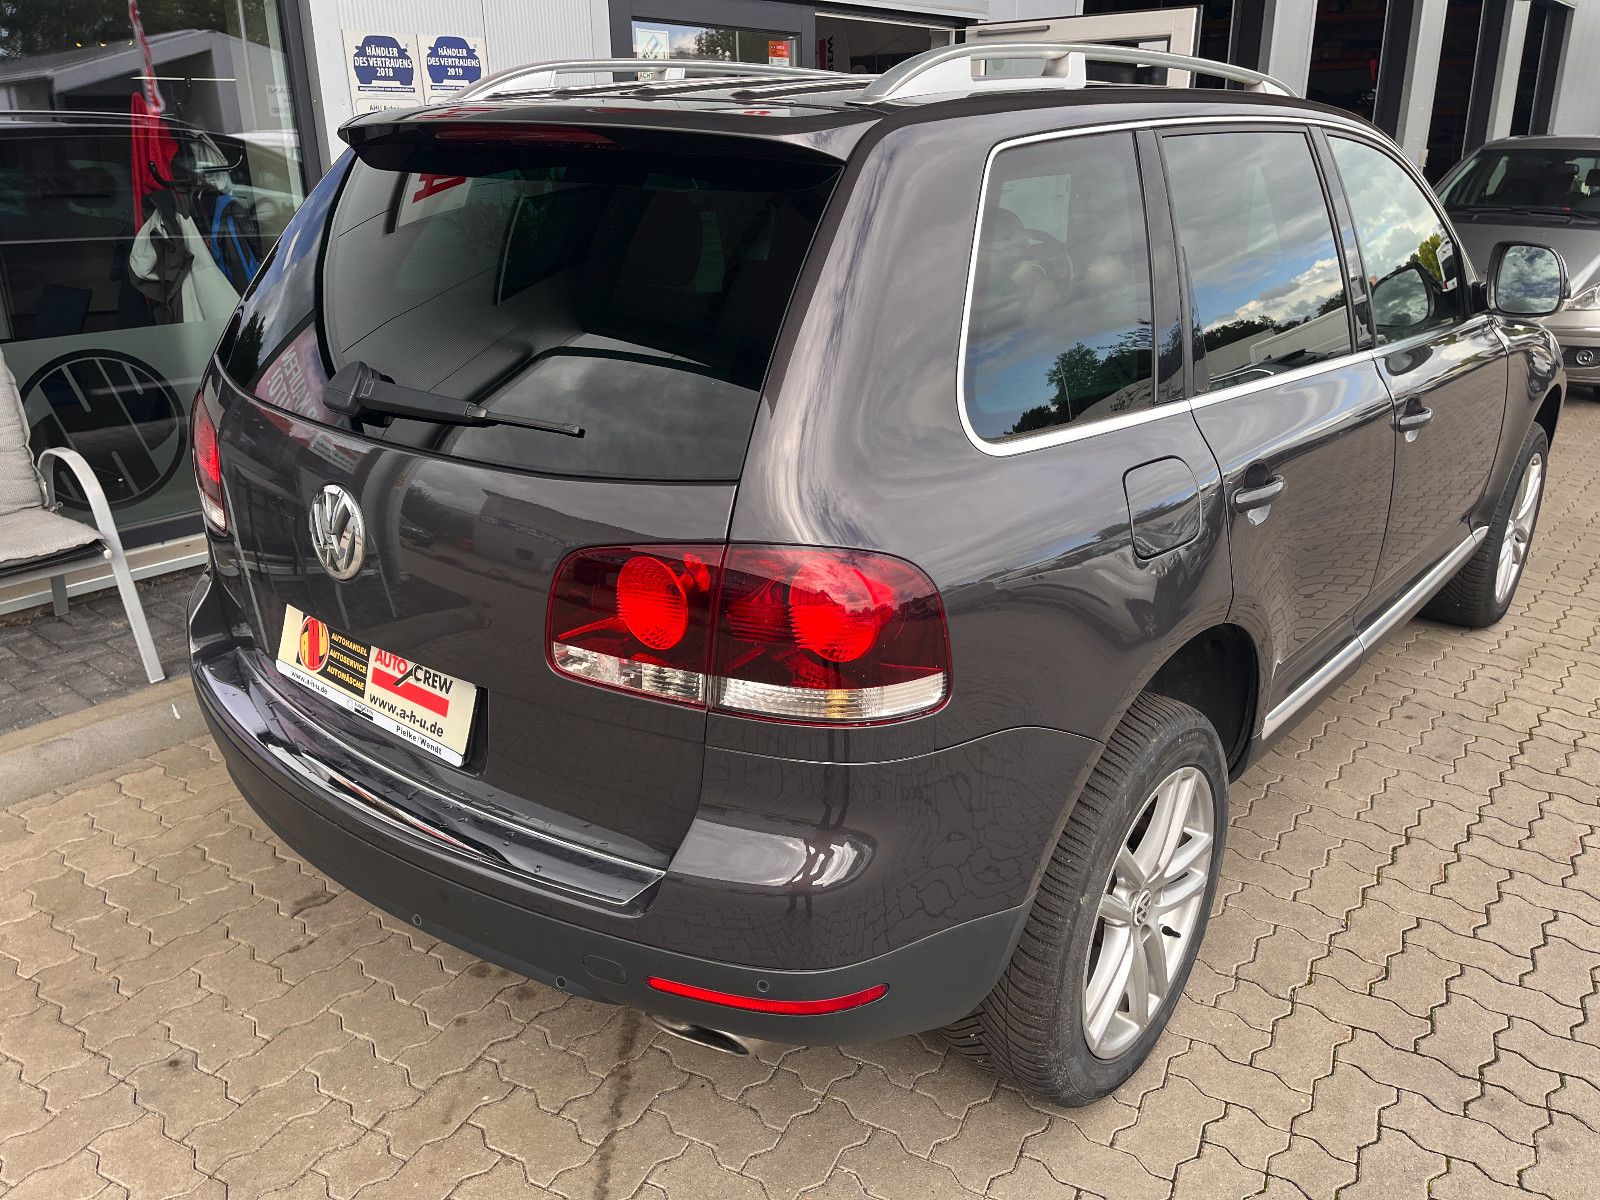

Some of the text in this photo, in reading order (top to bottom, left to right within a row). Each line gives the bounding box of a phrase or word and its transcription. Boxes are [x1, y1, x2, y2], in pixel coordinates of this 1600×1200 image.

[366, 45, 399, 57] HÄNDLER
[438, 46, 467, 57] HÄNDLER
[354, 56, 412, 69] DES VERTRAUENS
[427, 57, 480, 67] DES VERTRAUENS
[376, 67, 394, 77] 2018
[447, 67, 463, 76] 2019
[331, 632, 368, 657] AUTOHANDEL
[329, 649, 367, 674] AUTOSERVICE
[369, 693, 444, 738] www.a-h-u.de
